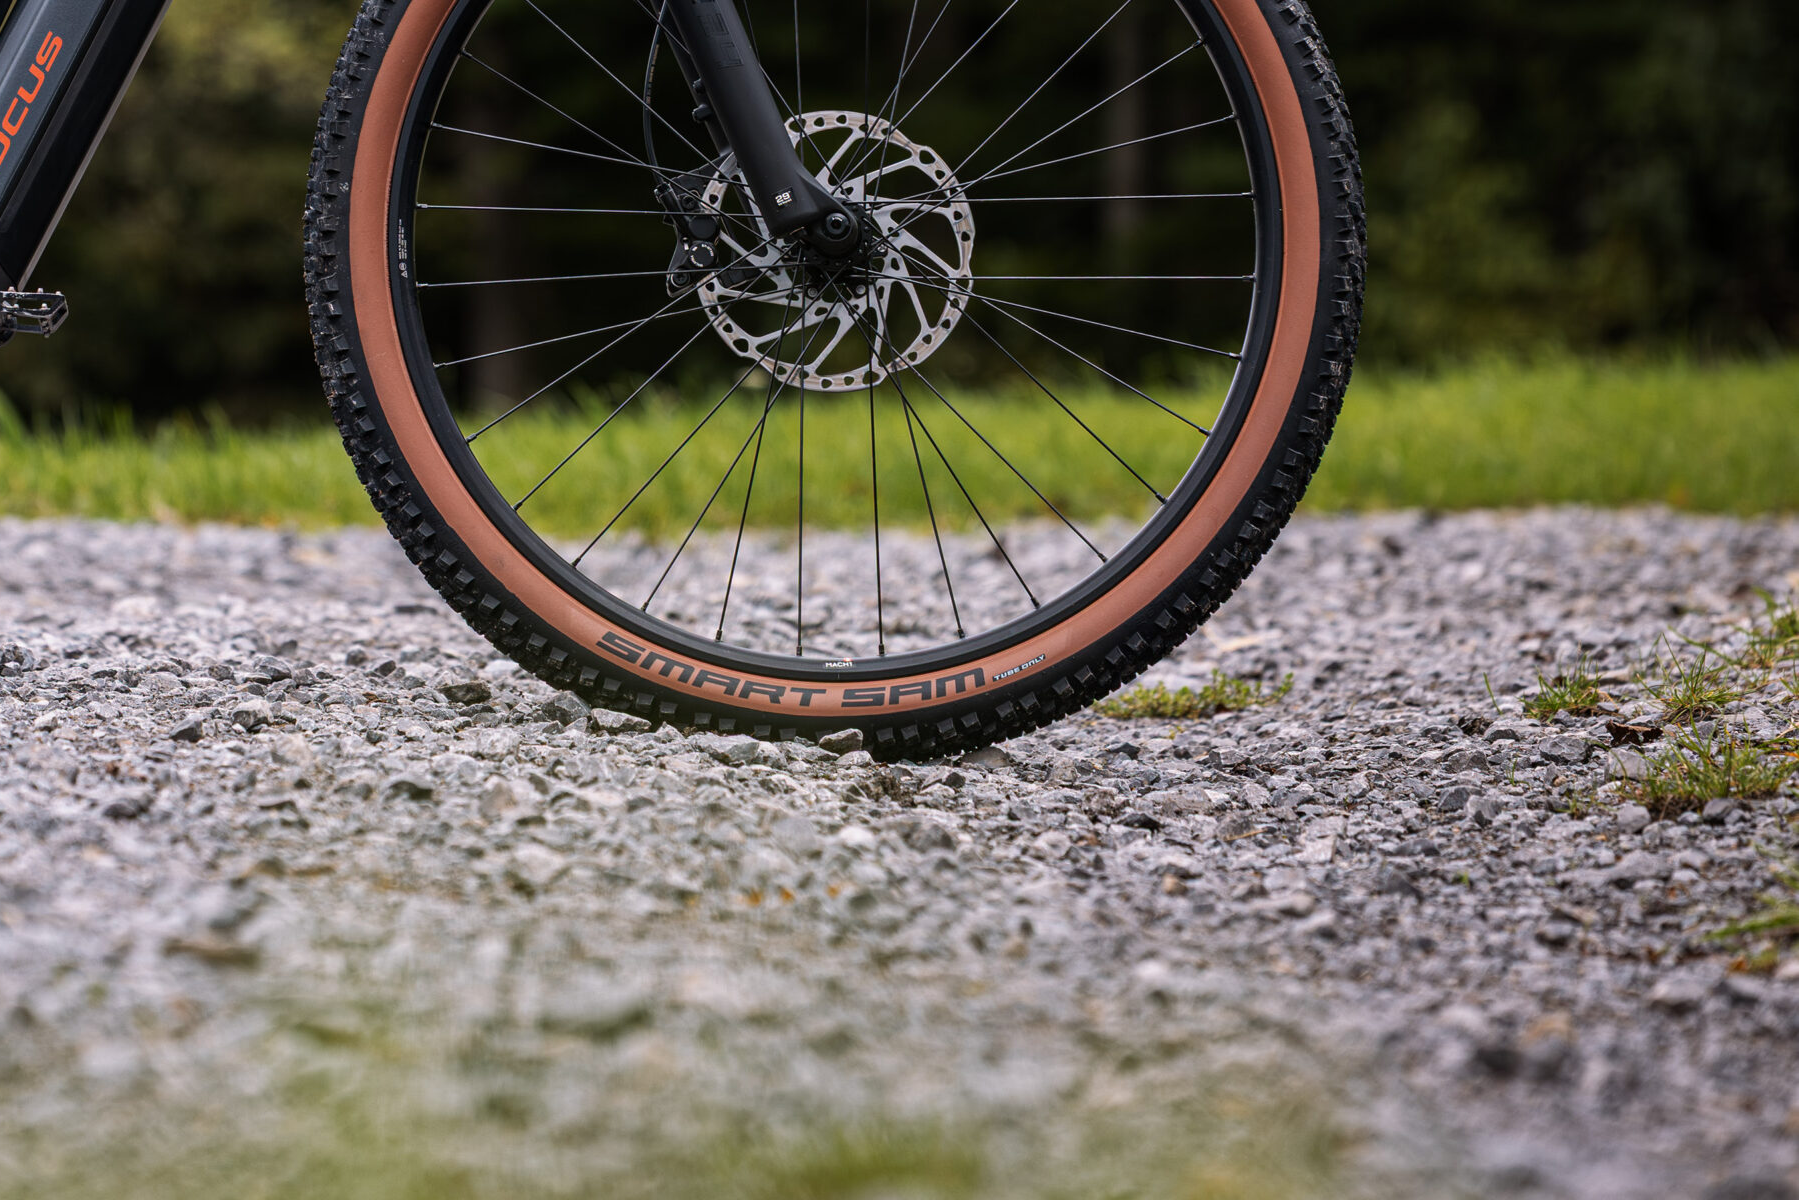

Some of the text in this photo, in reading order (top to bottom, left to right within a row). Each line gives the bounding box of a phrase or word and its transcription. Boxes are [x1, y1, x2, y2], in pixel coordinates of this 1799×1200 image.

[595, 631, 986, 708] SMART SAM
[992, 654, 1046, 682] TUBE ONLY
